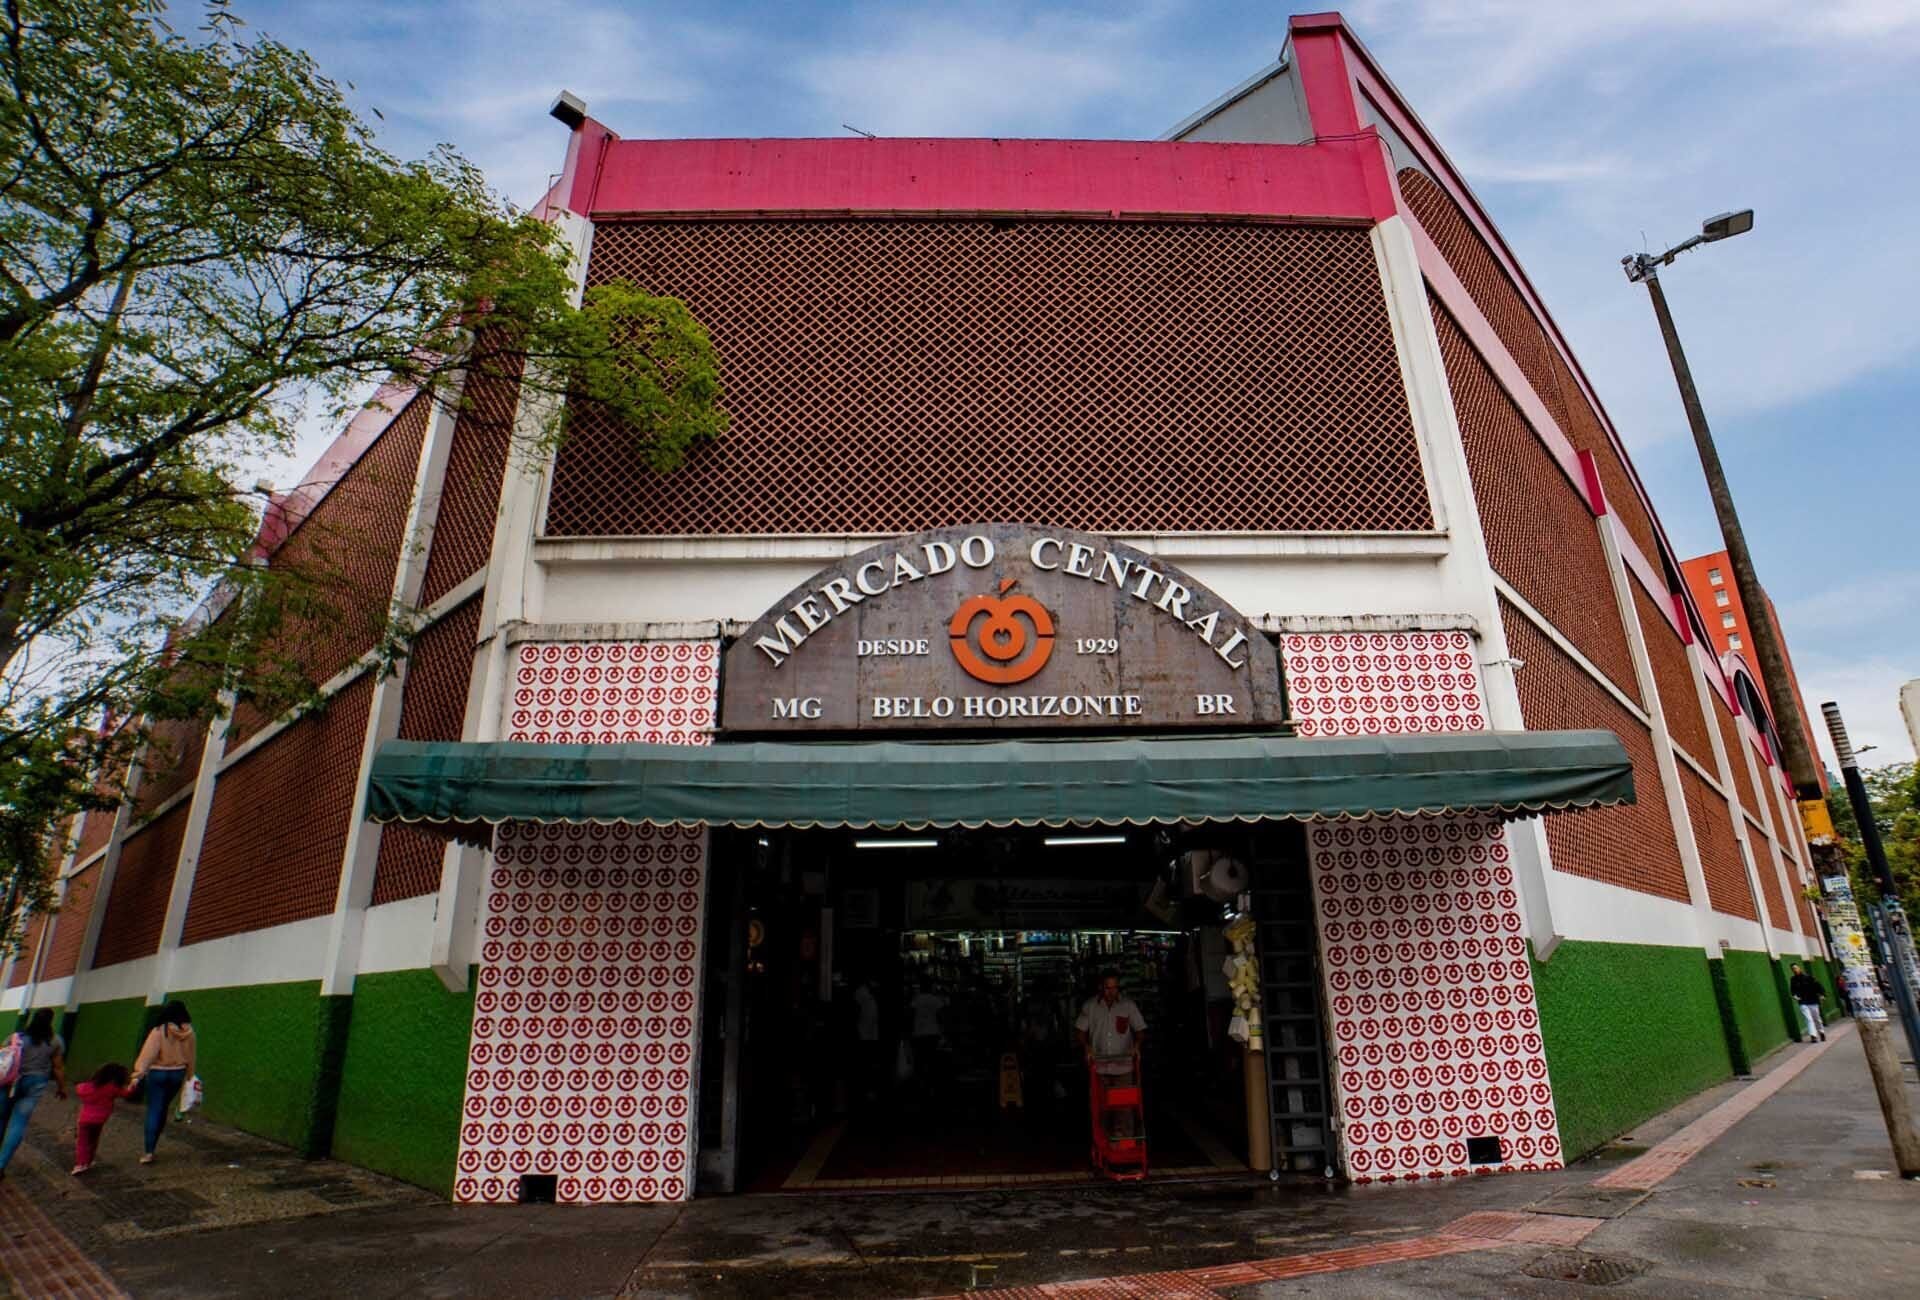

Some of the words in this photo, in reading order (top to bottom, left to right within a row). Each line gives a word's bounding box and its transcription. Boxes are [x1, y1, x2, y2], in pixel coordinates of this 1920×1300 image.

[753, 534, 996, 669] MERCADO
[1029, 536, 1251, 671] CENTRAL
[857, 639, 930, 656] DESDE
[1075, 638, 1119, 655] 1929
[771, 697, 822, 719] MG
[872, 696, 955, 719] BELO
[962, 694, 1143, 719] HORIZONTE
[1197, 694, 1237, 716] BR
